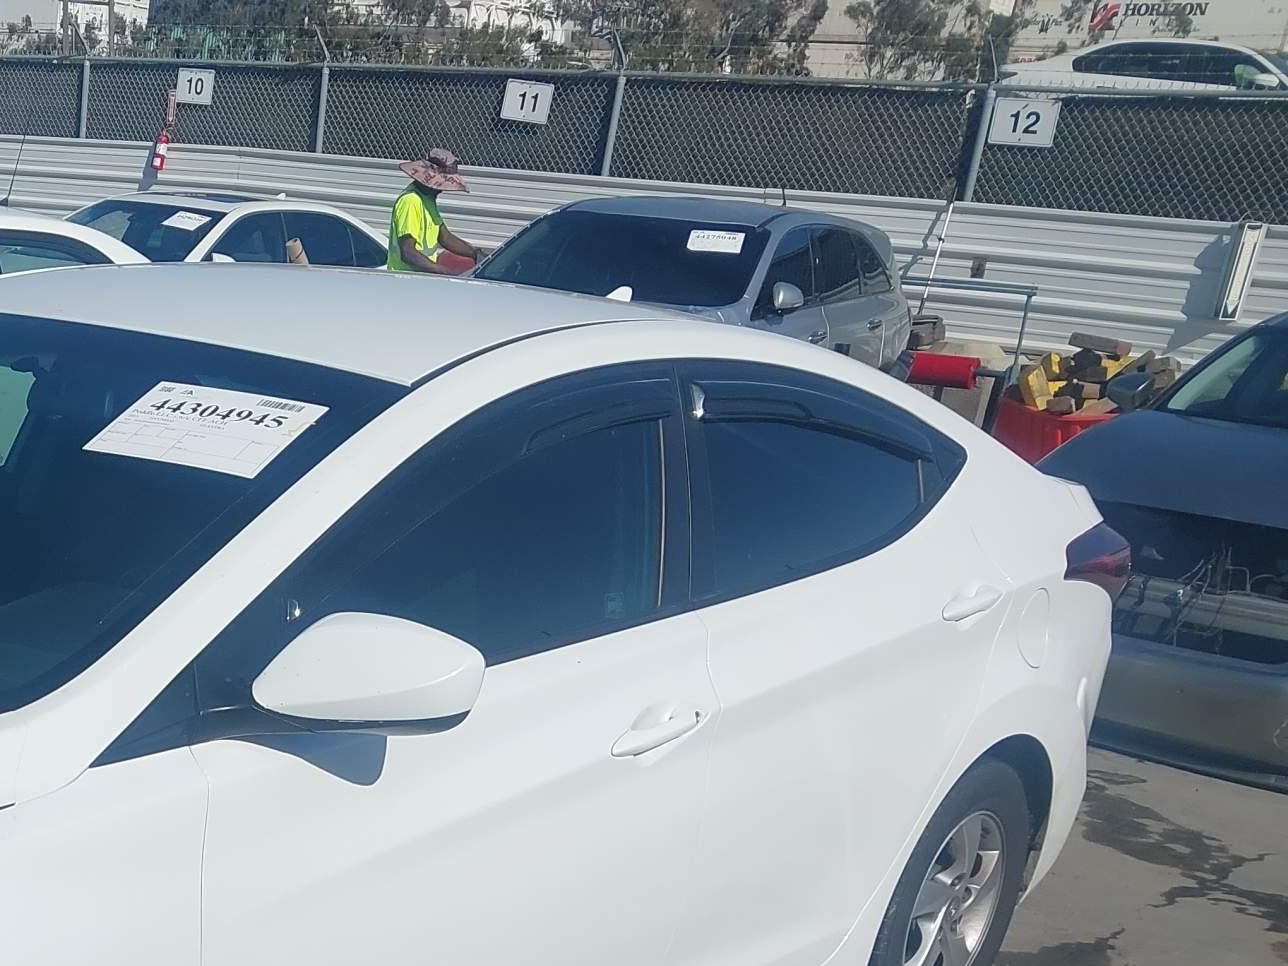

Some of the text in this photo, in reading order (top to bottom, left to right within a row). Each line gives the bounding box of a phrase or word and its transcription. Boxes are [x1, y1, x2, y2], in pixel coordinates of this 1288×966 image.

[1122, 2, 1210, 17] HORIZON
[186, 76, 205, 96] 10
[518, 91, 541, 113] 11
[1010, 110, 1041, 135] 12
[150, 398, 289, 429] 44304945
